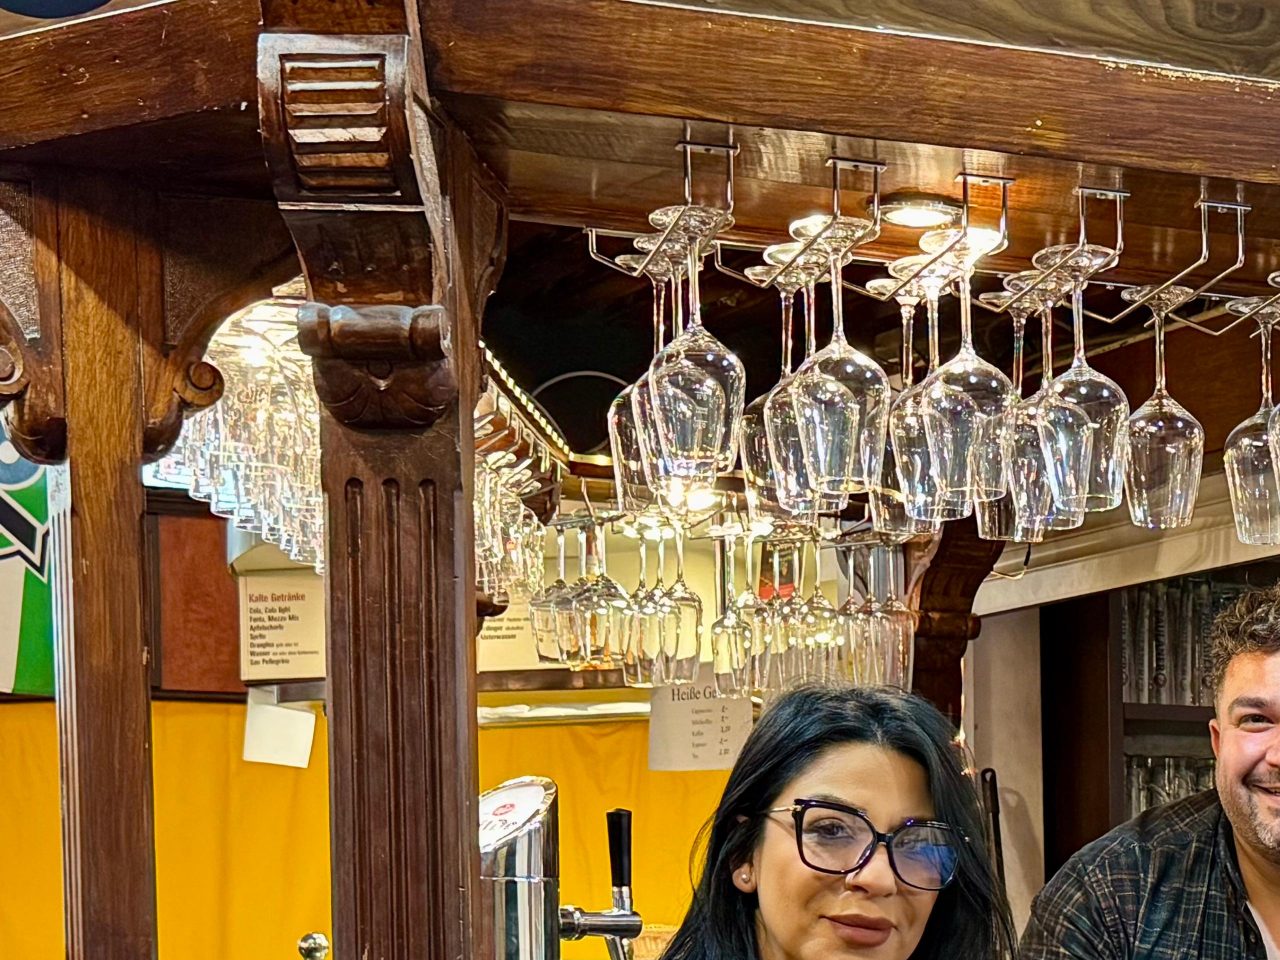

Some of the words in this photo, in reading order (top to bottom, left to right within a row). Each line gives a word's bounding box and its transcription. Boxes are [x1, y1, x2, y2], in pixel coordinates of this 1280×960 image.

[249, 593, 268, 602] Kalte
[271, 592, 306, 602] Getränke
[671, 687, 701, 701] Heiße
